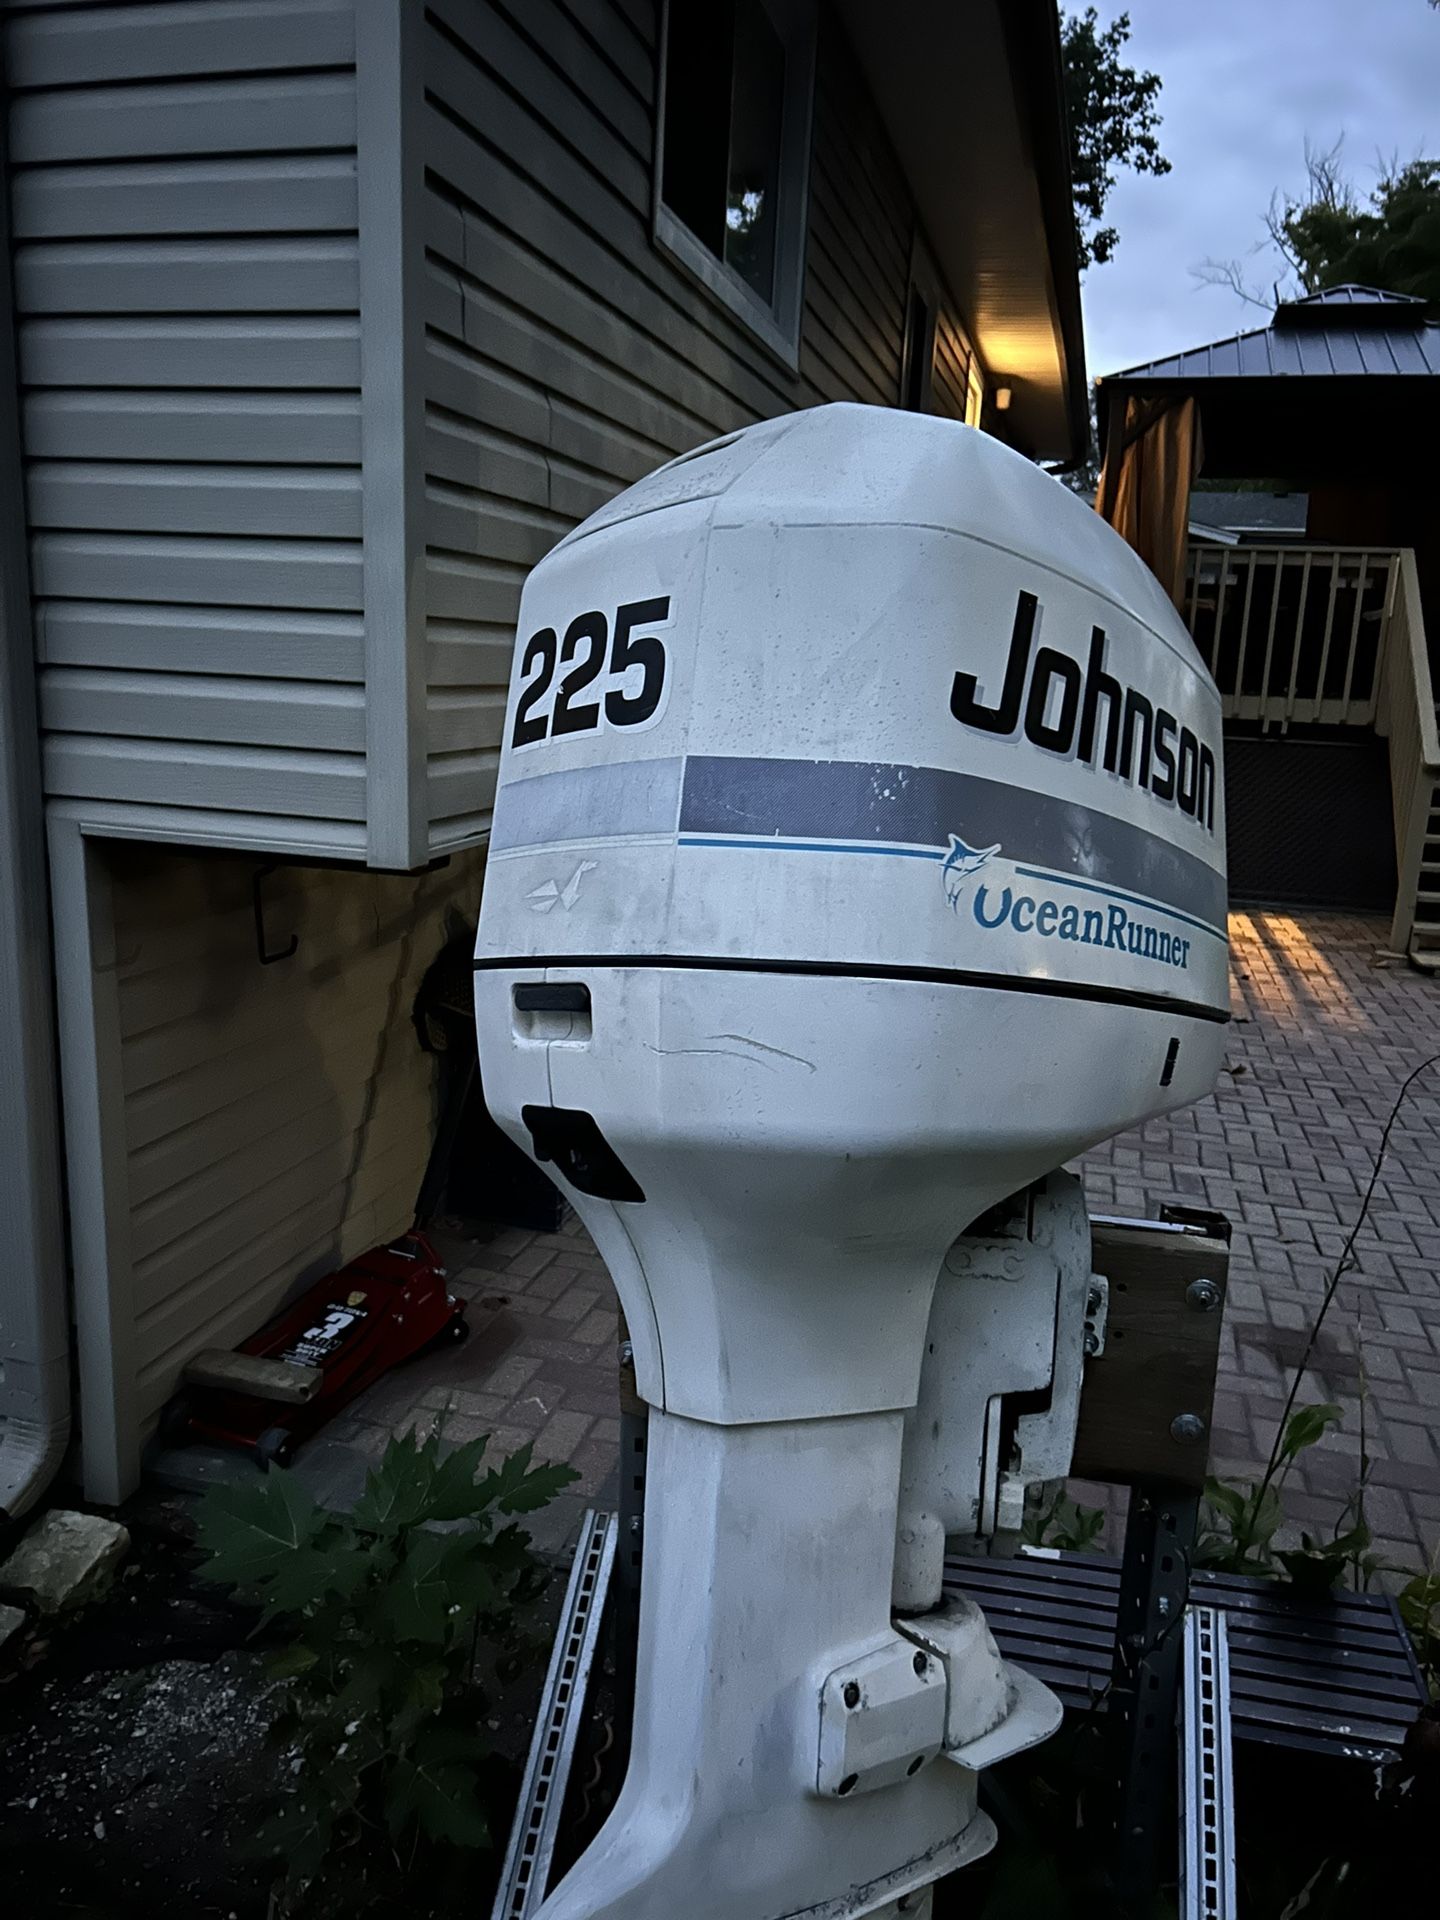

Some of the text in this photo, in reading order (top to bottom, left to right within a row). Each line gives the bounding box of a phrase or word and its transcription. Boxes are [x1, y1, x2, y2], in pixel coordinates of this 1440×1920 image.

[512, 595, 671, 749] 225
[949, 589, 1215, 834] Johnson
[303, 1311, 355, 1339] 3
